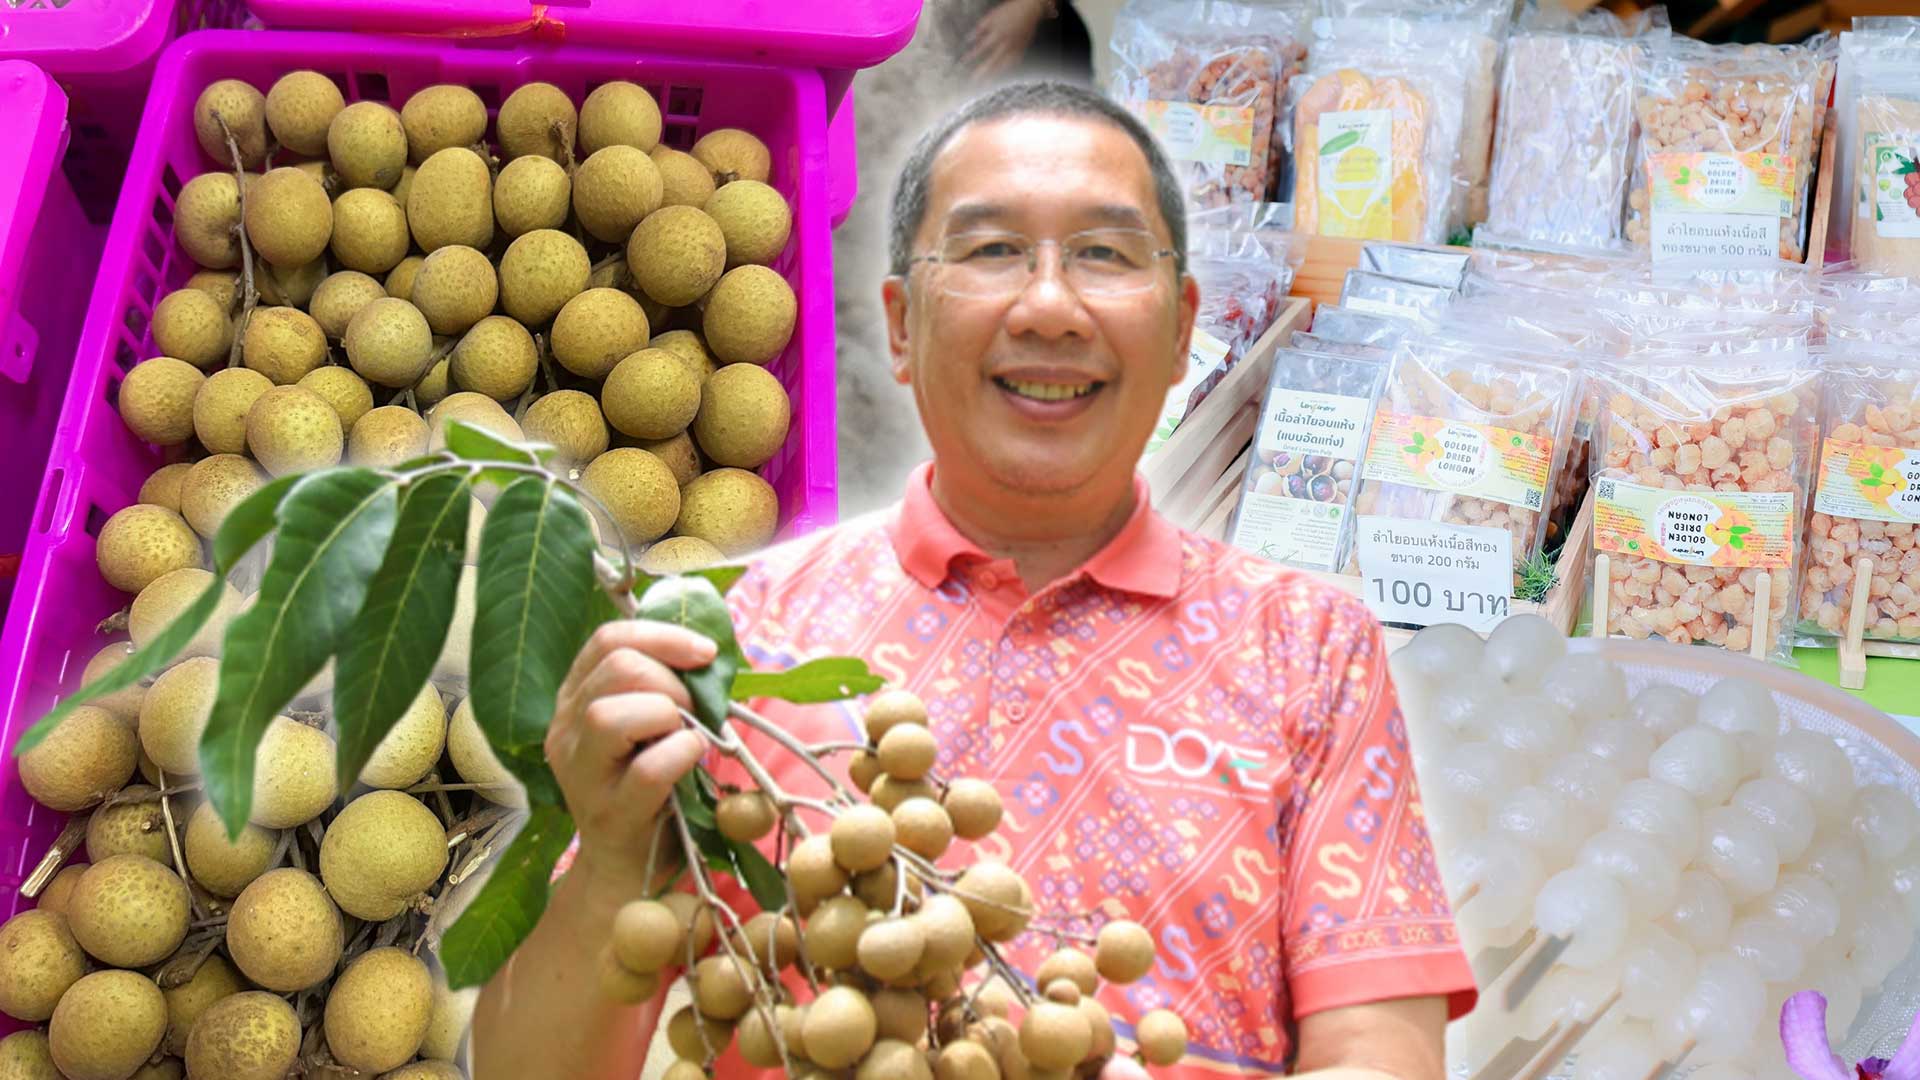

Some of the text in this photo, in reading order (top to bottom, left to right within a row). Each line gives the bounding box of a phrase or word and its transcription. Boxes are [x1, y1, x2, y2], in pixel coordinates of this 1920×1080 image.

[1721, 244, 1745, 256] 500
[1274, 408, 1355, 431] เนื้อลำไยอบแห้ง
[1277, 430, 1345, 448] (แบบอัดแท่ง)
[1444, 440, 1479, 454] GOLDEN
[1446, 452, 1472, 463] DRIED
[1438, 461, 1475, 475] LONGAN
[1668, 511, 1708, 522] LONGAN
[1674, 523, 1701, 532] DRIED
[1372, 530, 1497, 553] ลำไยอบแห้งเนื้อสีทอง
[1668, 533, 1706, 544] GOLDEN
[1390, 553, 1480, 569] ขนาด 200 กรัม
[1372, 578, 1508, 617] 100 บาท
